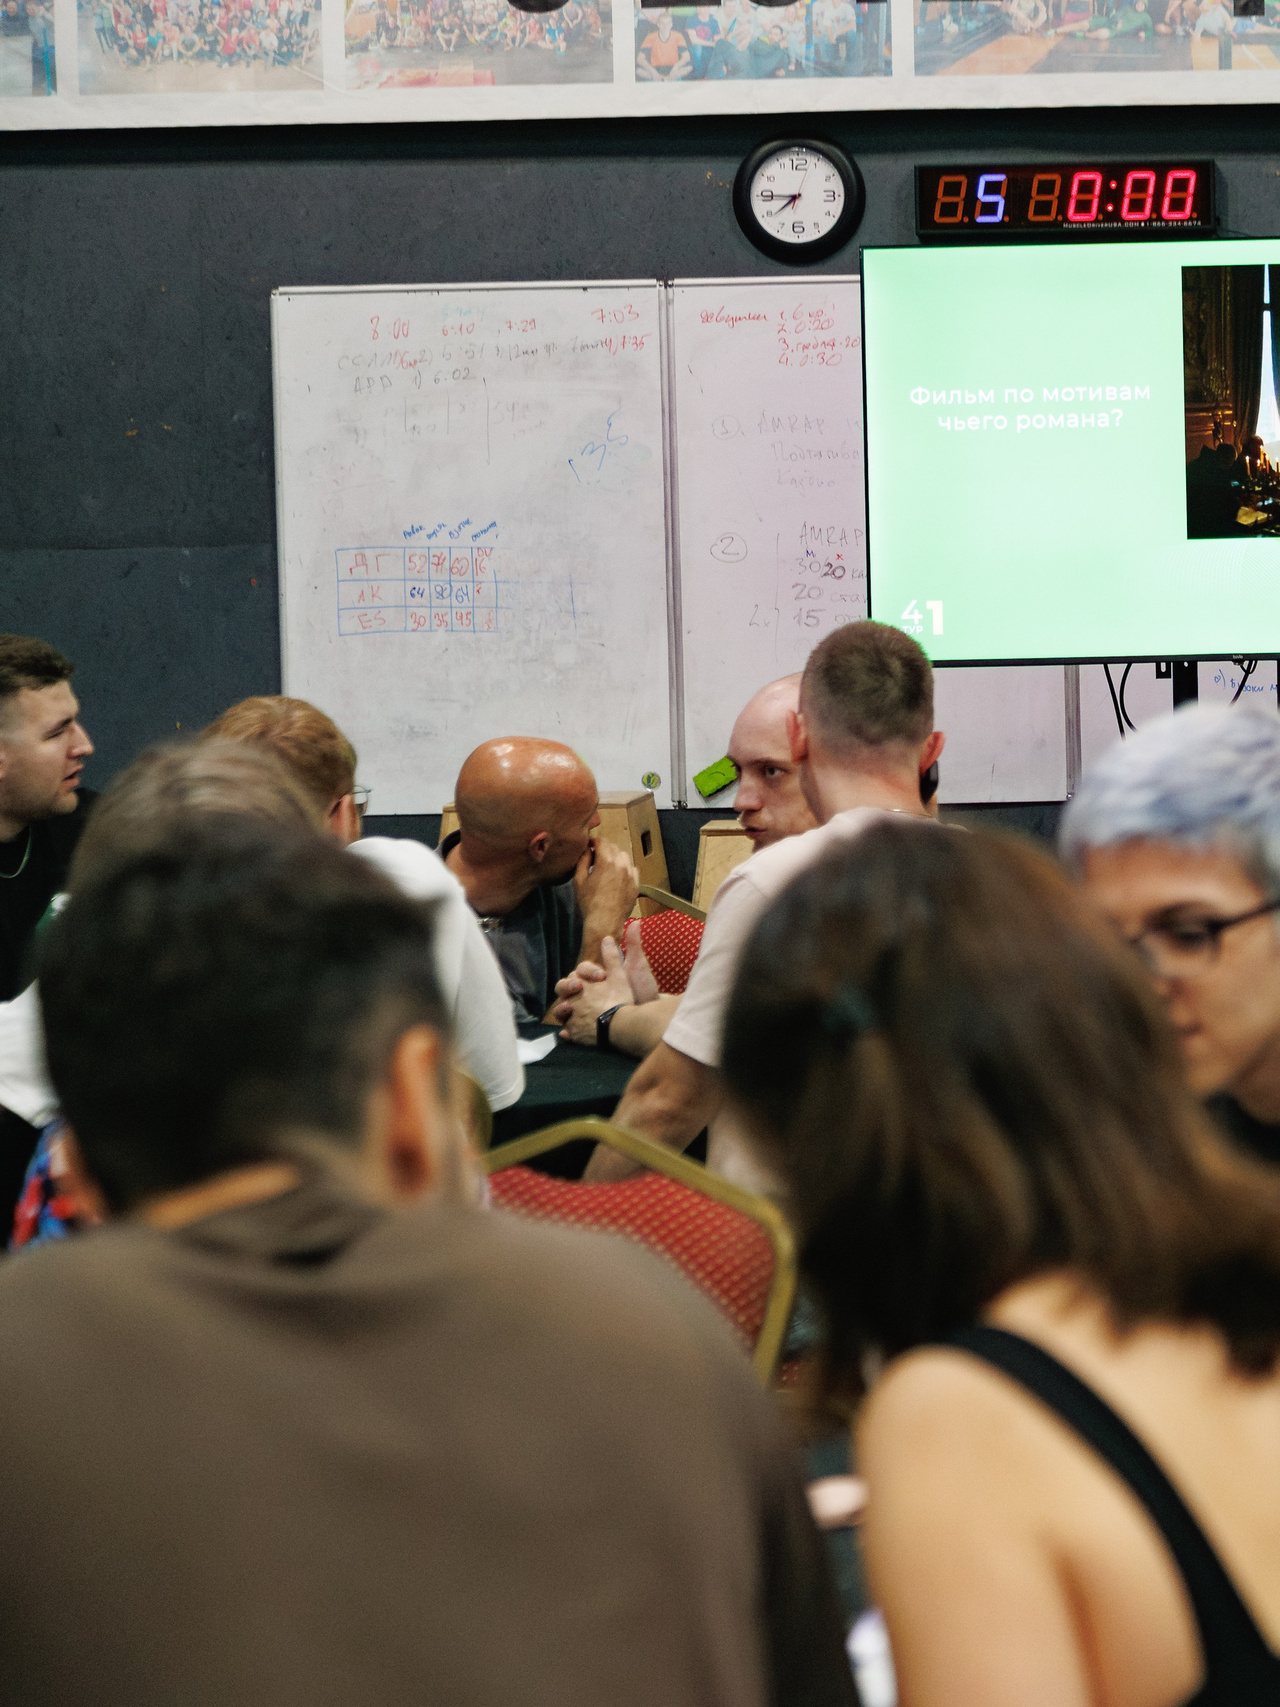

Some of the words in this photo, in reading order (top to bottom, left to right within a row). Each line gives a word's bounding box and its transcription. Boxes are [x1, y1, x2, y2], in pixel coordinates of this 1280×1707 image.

[909, 386, 995, 407] Фильм
[1003, 388, 1034, 404] по
[1042, 385, 1151, 403] мотивам
[937, 414, 1008, 432] чьего
[1016, 408, 1124, 434] романа?
[409, 587, 426, 599] 64
[455, 584, 471, 604] 64
[410, 612, 427, 632] 30
[455, 611, 472, 628] 45
